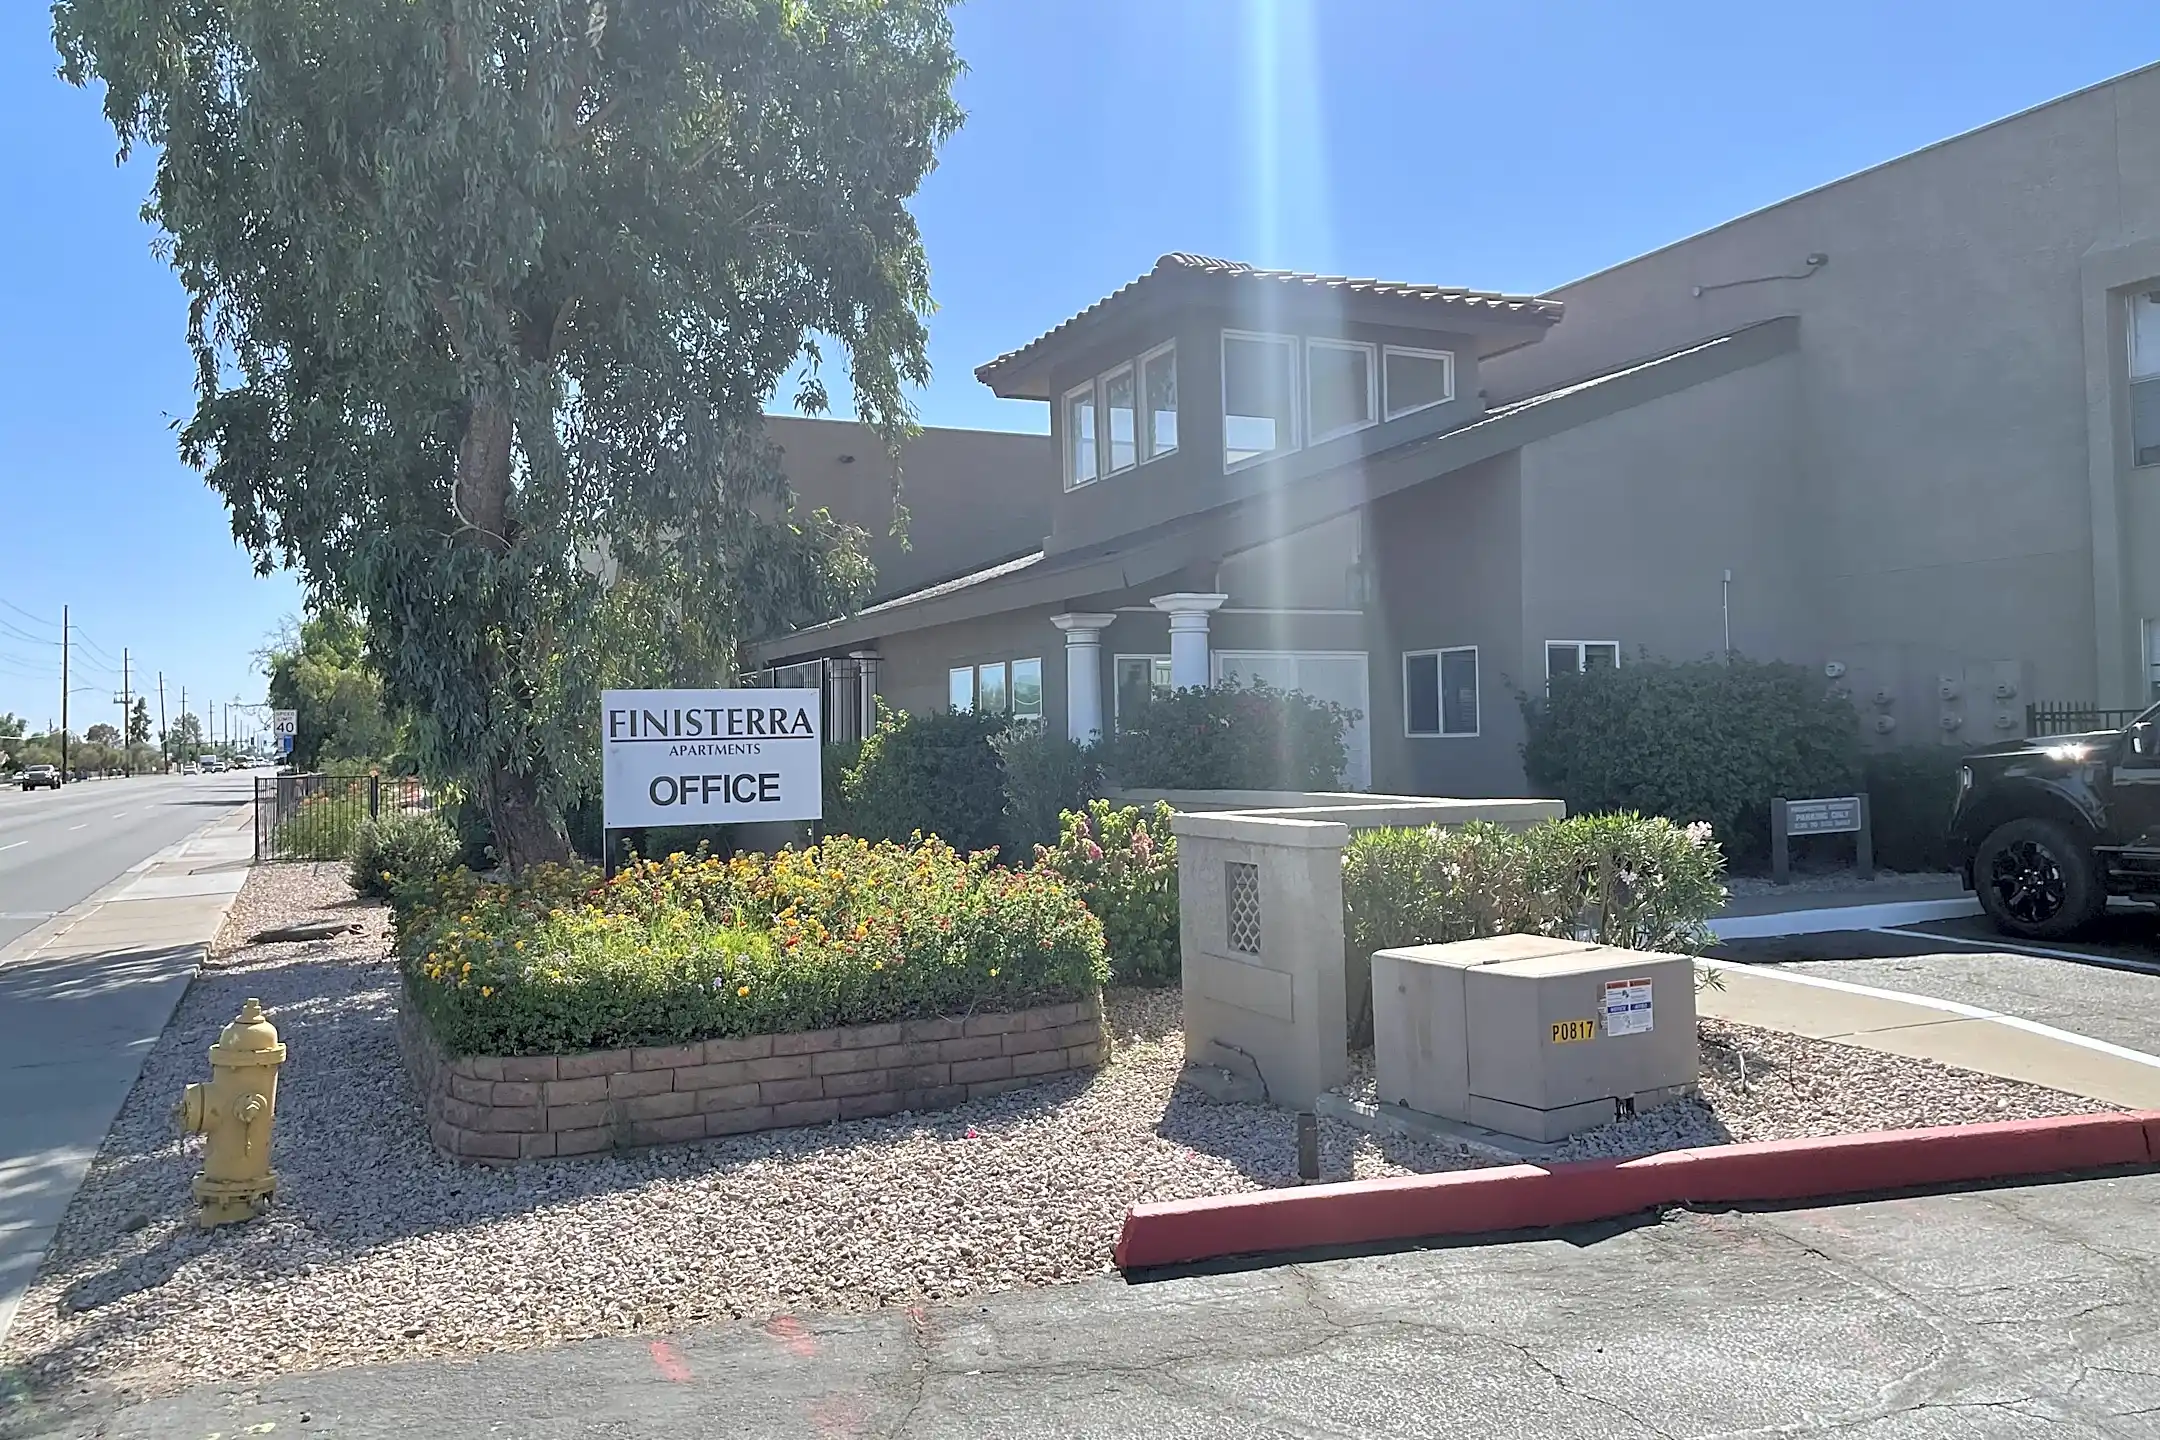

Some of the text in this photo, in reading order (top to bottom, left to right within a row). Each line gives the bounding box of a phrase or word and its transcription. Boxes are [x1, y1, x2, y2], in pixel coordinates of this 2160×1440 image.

[276, 722, 293, 732] 40
[609, 708, 814, 738] FINISTERRA
[669, 743, 761, 757] APARTMENTS
[649, 773, 781, 806] OFFICE
[1553, 1021, 1593, 1041] P0817
